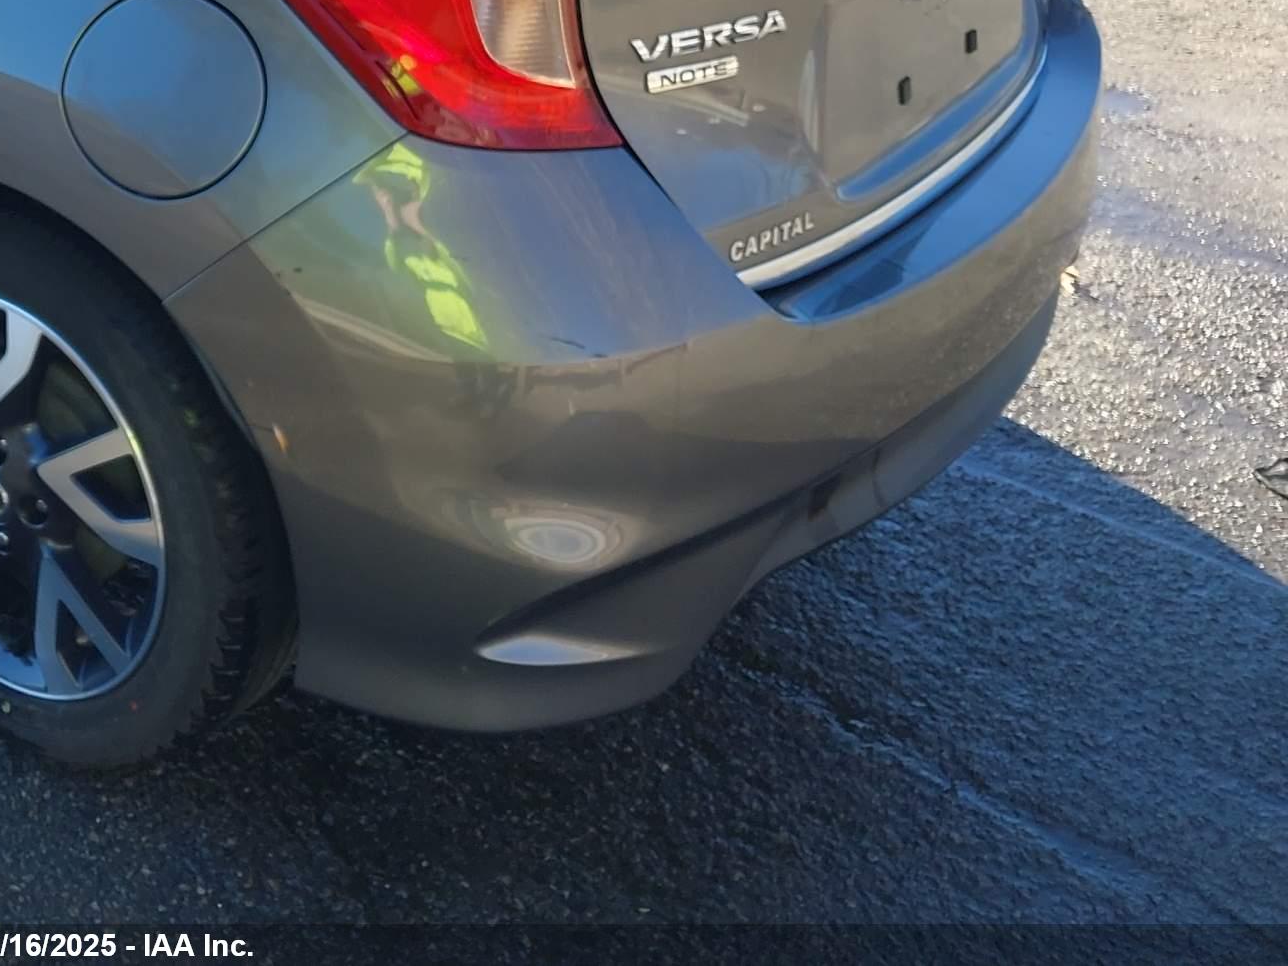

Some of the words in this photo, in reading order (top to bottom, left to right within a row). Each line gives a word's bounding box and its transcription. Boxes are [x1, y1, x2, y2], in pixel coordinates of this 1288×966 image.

[630, 9, 788, 62] VERSA
[660, 61, 730, 88] NOTE
[730, 212, 815, 262] CAPITAL
